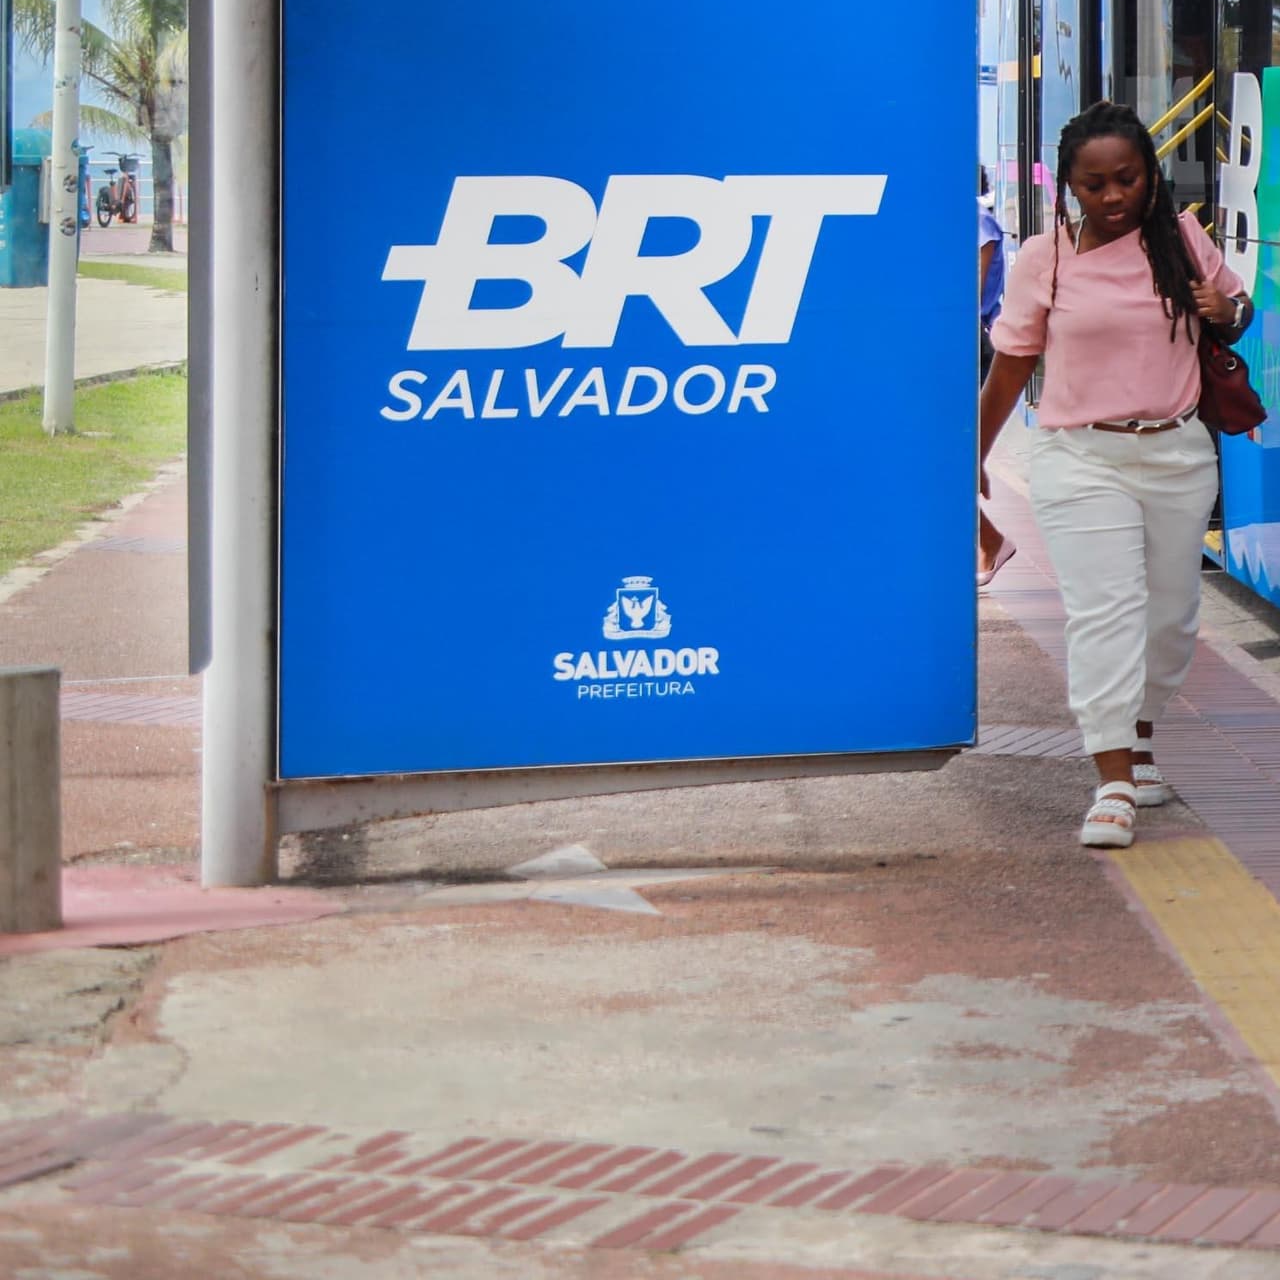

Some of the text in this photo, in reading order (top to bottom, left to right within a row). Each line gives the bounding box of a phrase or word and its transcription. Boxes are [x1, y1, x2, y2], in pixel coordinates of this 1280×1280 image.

[381, 174, 888, 352] BRT
[379, 363, 777, 422] SALVADOR
[552, 647, 720, 681] SALVADOR
[577, 681, 696, 699] PREFEITURA
